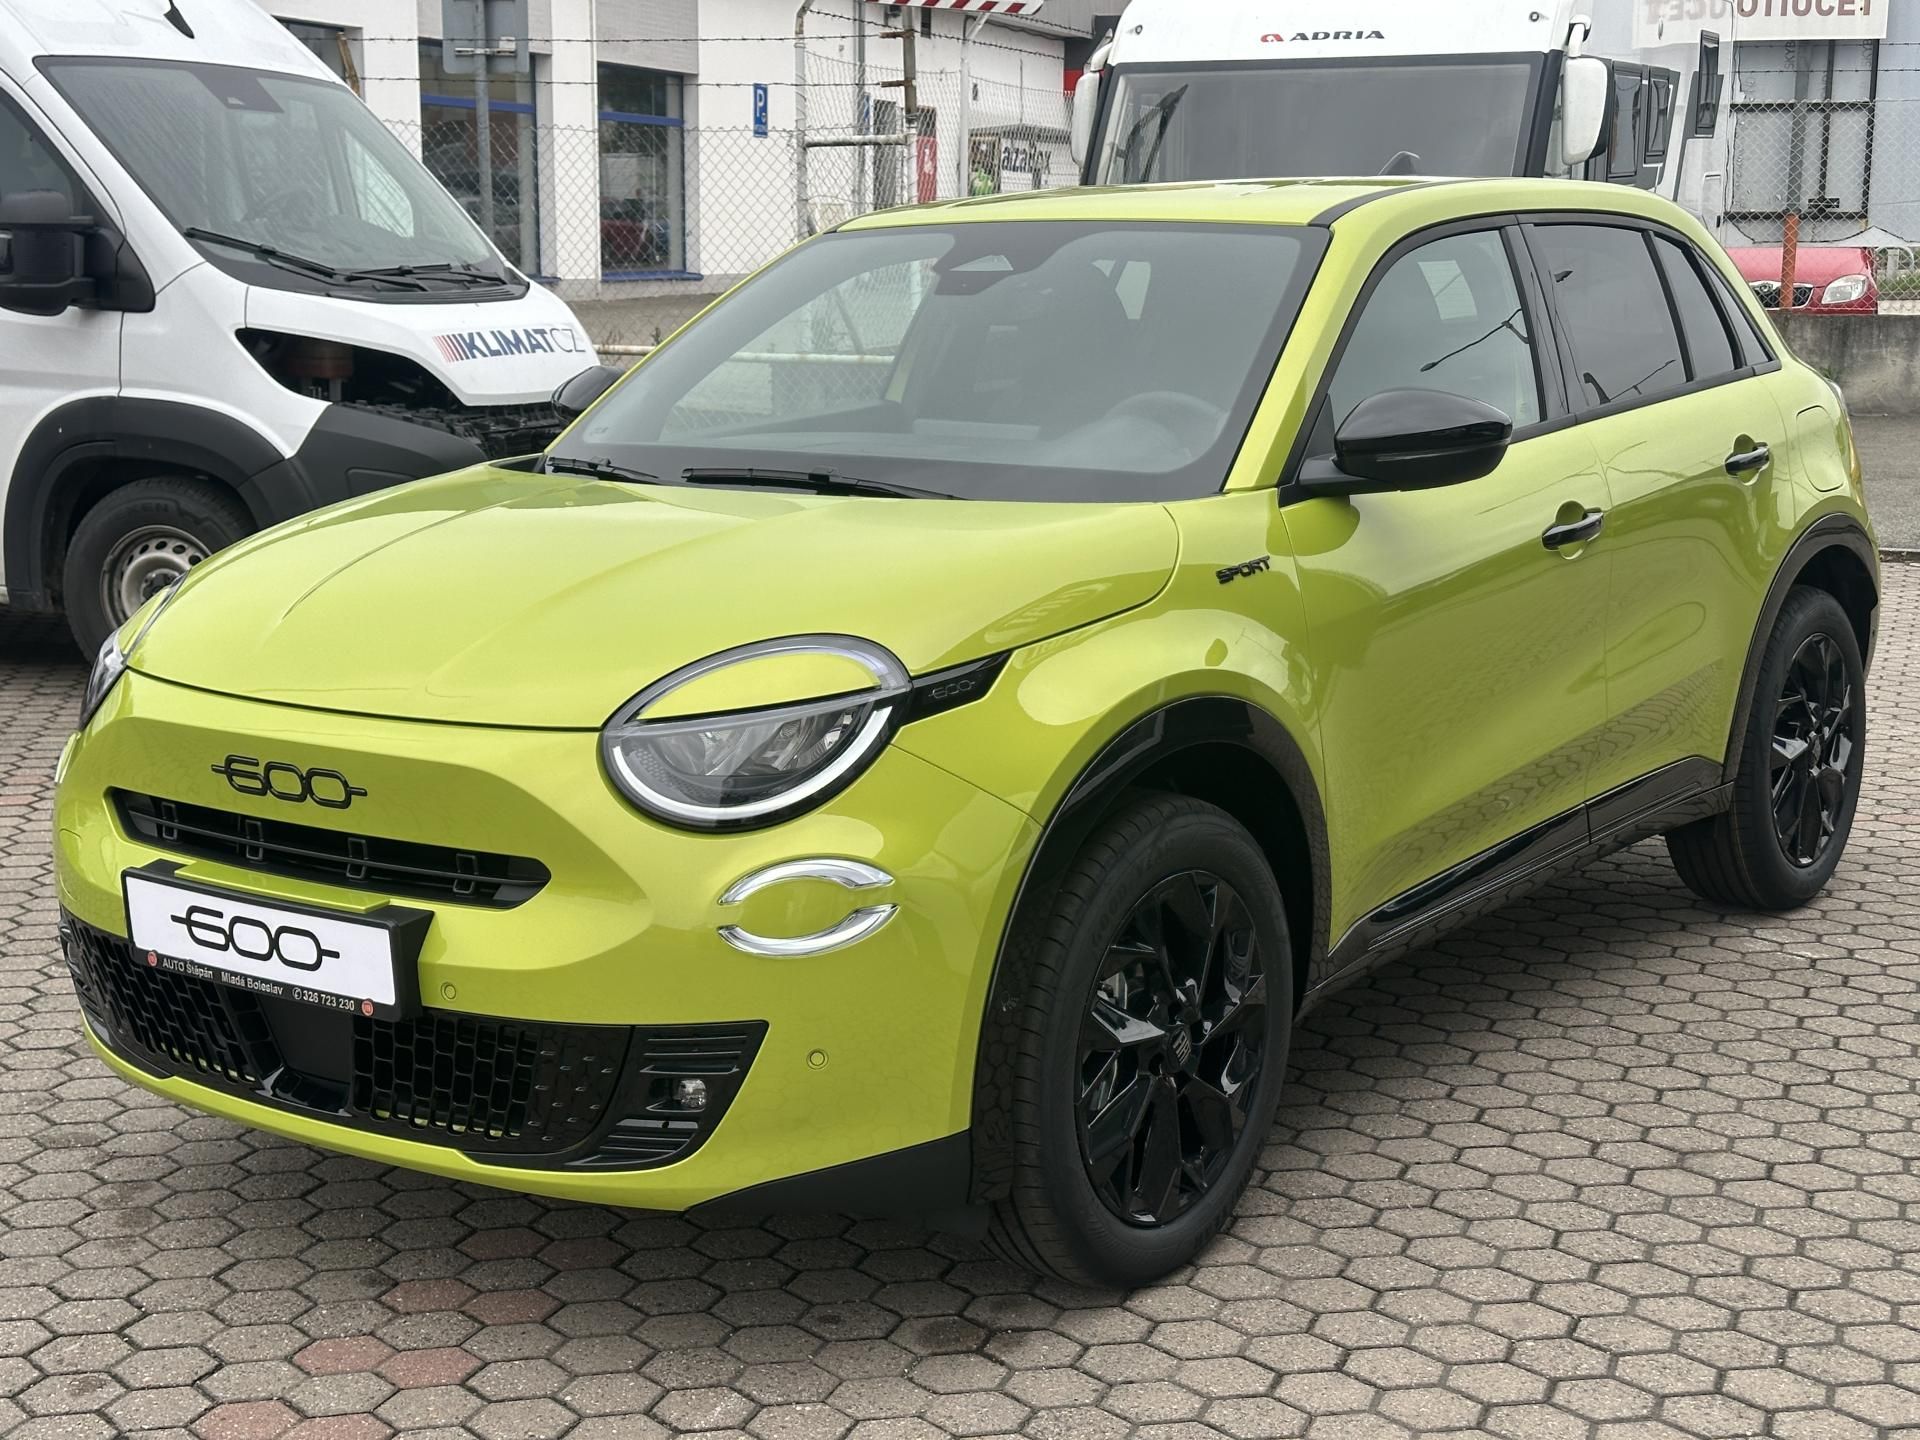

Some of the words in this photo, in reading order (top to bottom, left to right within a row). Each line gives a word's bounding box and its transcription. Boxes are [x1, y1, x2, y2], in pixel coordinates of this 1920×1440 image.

[1290, 30, 1385, 42] ADRIA
[756, 88, 765, 117] P
[1216, 554, 1270, 585] SPORT
[224, 754, 352, 809] 600
[186, 905, 323, 972] 600
[162, 958, 185, 972] AUTO
[186, 960, 214, 980] Štěpán
[221, 971, 245, 985] Mladá
[247, 977, 284, 995] Boleslav
[303, 990, 319, 1003] 326
[320, 993, 336, 1007] 723
[339, 998, 355, 1011] 230
